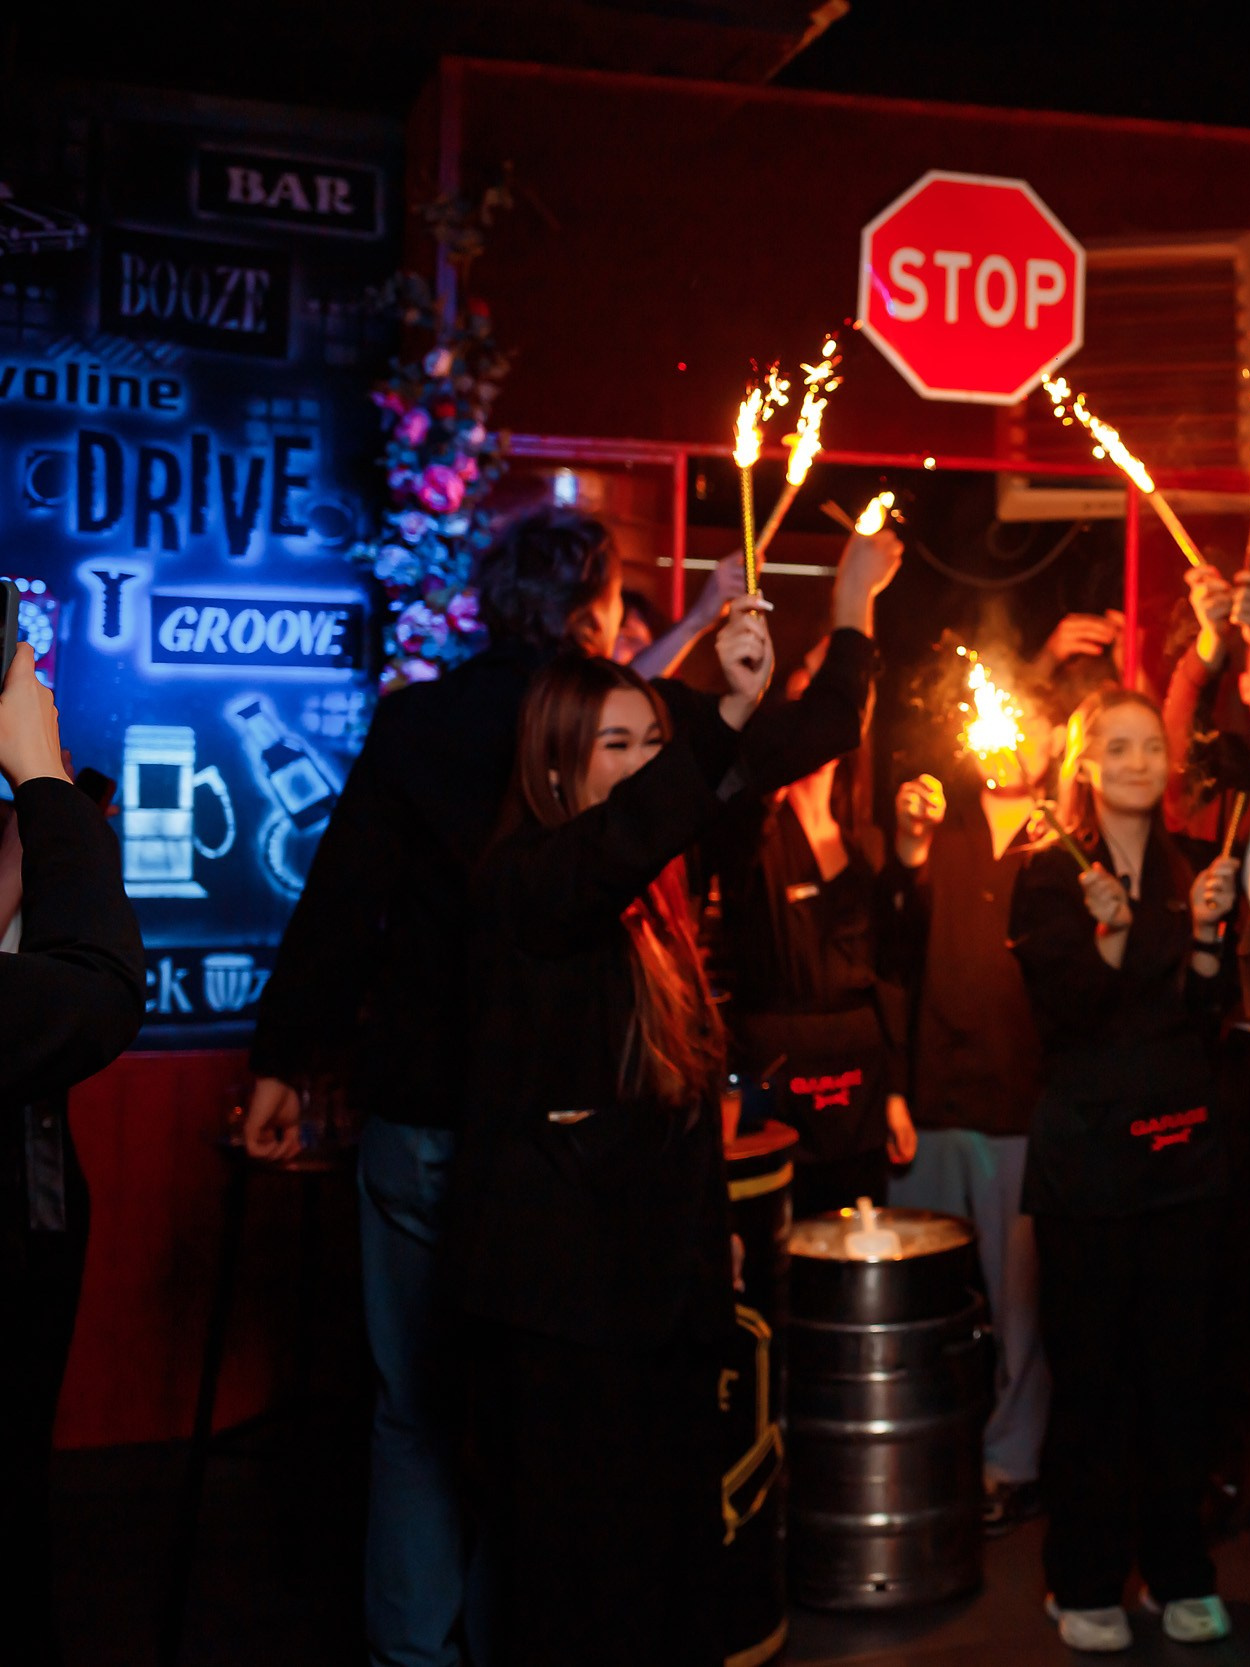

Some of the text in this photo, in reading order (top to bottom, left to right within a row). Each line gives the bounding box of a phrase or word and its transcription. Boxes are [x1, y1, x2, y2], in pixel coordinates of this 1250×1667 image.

[227, 166, 355, 214] BAR
[121, 251, 270, 333] BOOZE
[889, 247, 1066, 330] STOP
[77, 429, 313, 556] DRIVE
[159, 606, 347, 656] GROOVE
